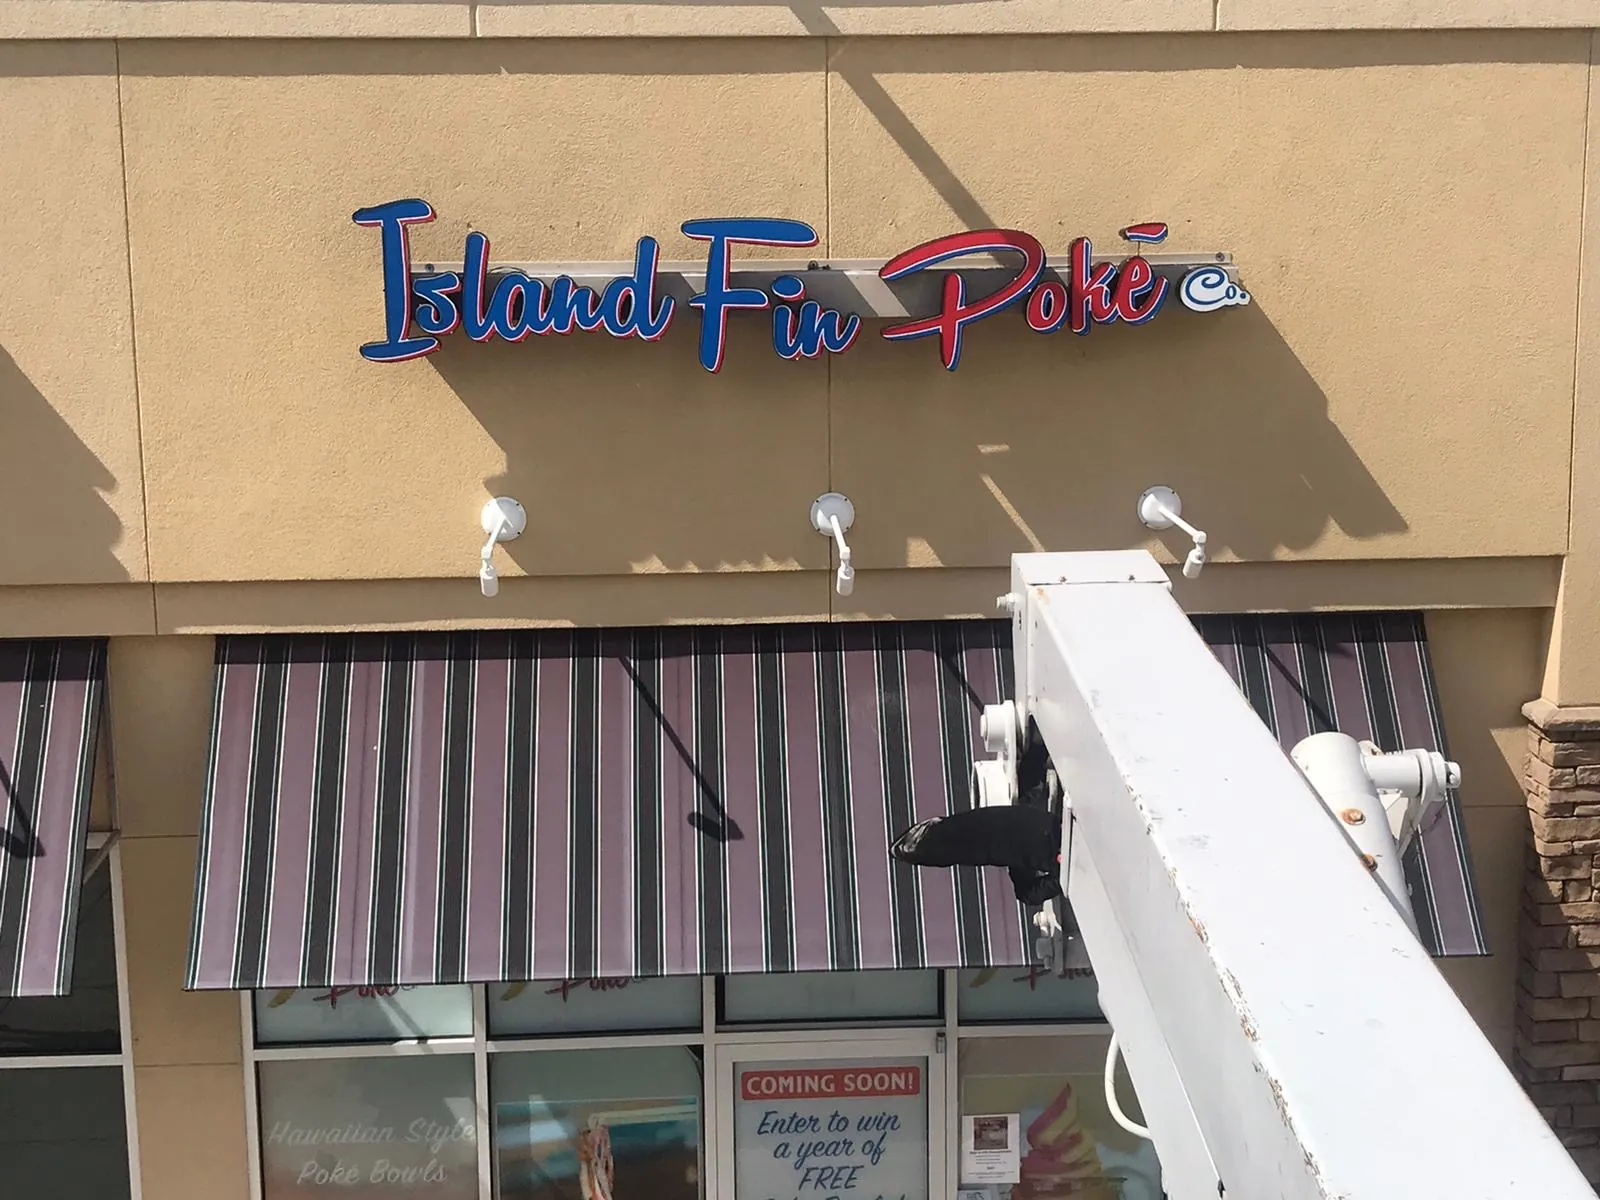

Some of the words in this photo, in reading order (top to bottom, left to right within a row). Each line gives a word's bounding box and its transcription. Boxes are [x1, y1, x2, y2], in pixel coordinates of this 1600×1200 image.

[352, 198, 677, 363] Island
[680, 217, 863, 373] Fin
[746, 1074, 836, 1096] COMING
[843, 1071, 915, 1093] SOON!
[267, 1121, 394, 1146] Hawaiian
[405, 1117, 476, 1154] Style
[757, 1110, 821, 1136] Enter
[827, 1110, 850, 1133] to
[857, 1111, 901, 1132] win
[773, 1142, 792, 1159] a
[794, 1138, 855, 1170] year
[862, 1131, 888, 1165] of
[369, 1157, 449, 1185] Bowls
[798, 1165, 865, 1190] FREE
